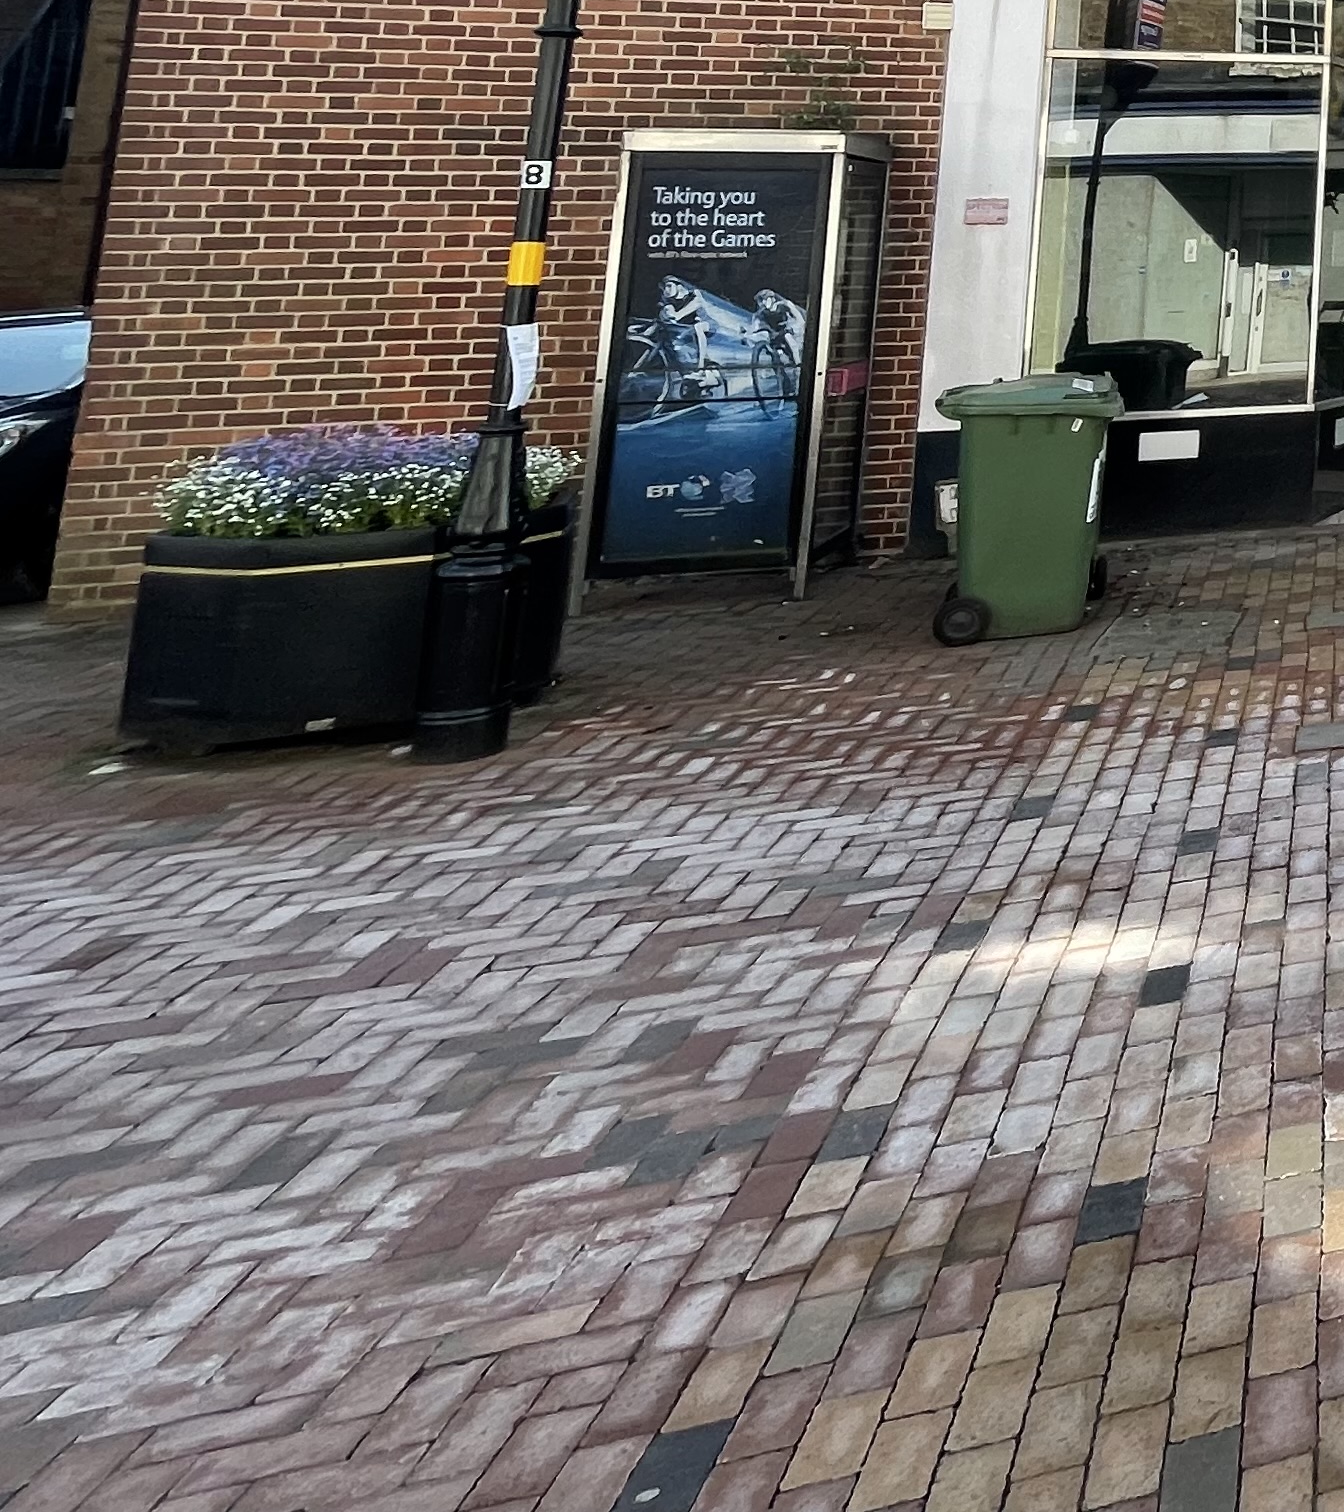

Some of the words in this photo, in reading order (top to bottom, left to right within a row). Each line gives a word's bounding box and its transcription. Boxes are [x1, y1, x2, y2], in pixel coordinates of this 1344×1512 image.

[525, 163, 544, 185] 8
[652, 186, 716, 209] Taking
[719, 191, 756, 209] you
[650, 210, 672, 226] to
[675, 208, 709, 226] the
[712, 208, 766, 227] heart
[647, 229, 672, 247] of
[673, 229, 706, 248] the
[711, 229, 776, 248] Games
[646, 483, 680, 499] BT
